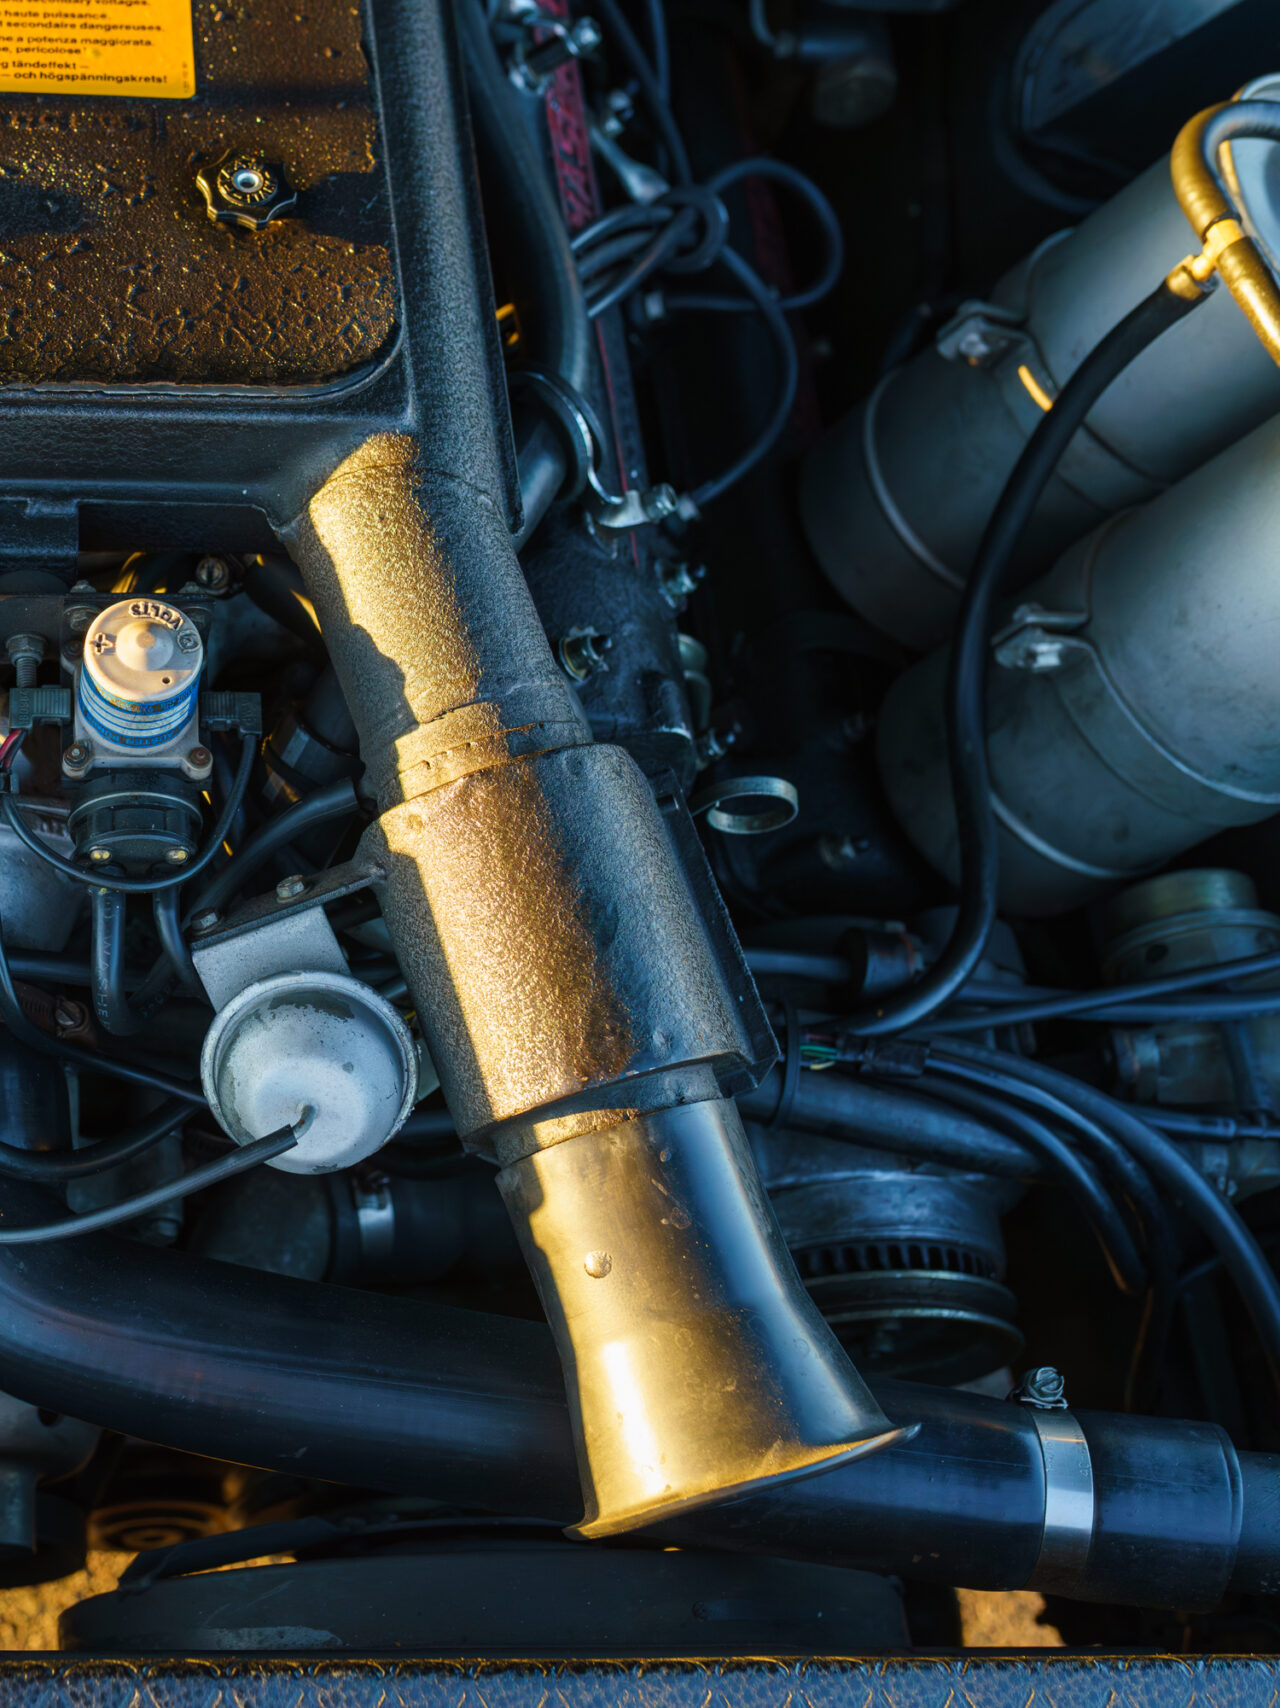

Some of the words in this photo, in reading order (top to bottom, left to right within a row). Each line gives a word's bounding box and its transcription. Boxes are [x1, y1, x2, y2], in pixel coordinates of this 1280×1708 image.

[4, 10, 39, 18] haute
[6, 20, 76, 29] secondaire
[27, 35, 77, 44] potenza
[12, 60, 77, 70] tändeffekt
[14, 71, 37, 79] och
[40, 71, 168, 84] högspänningskrets!
[129, 602, 184, 630] VOLTS
